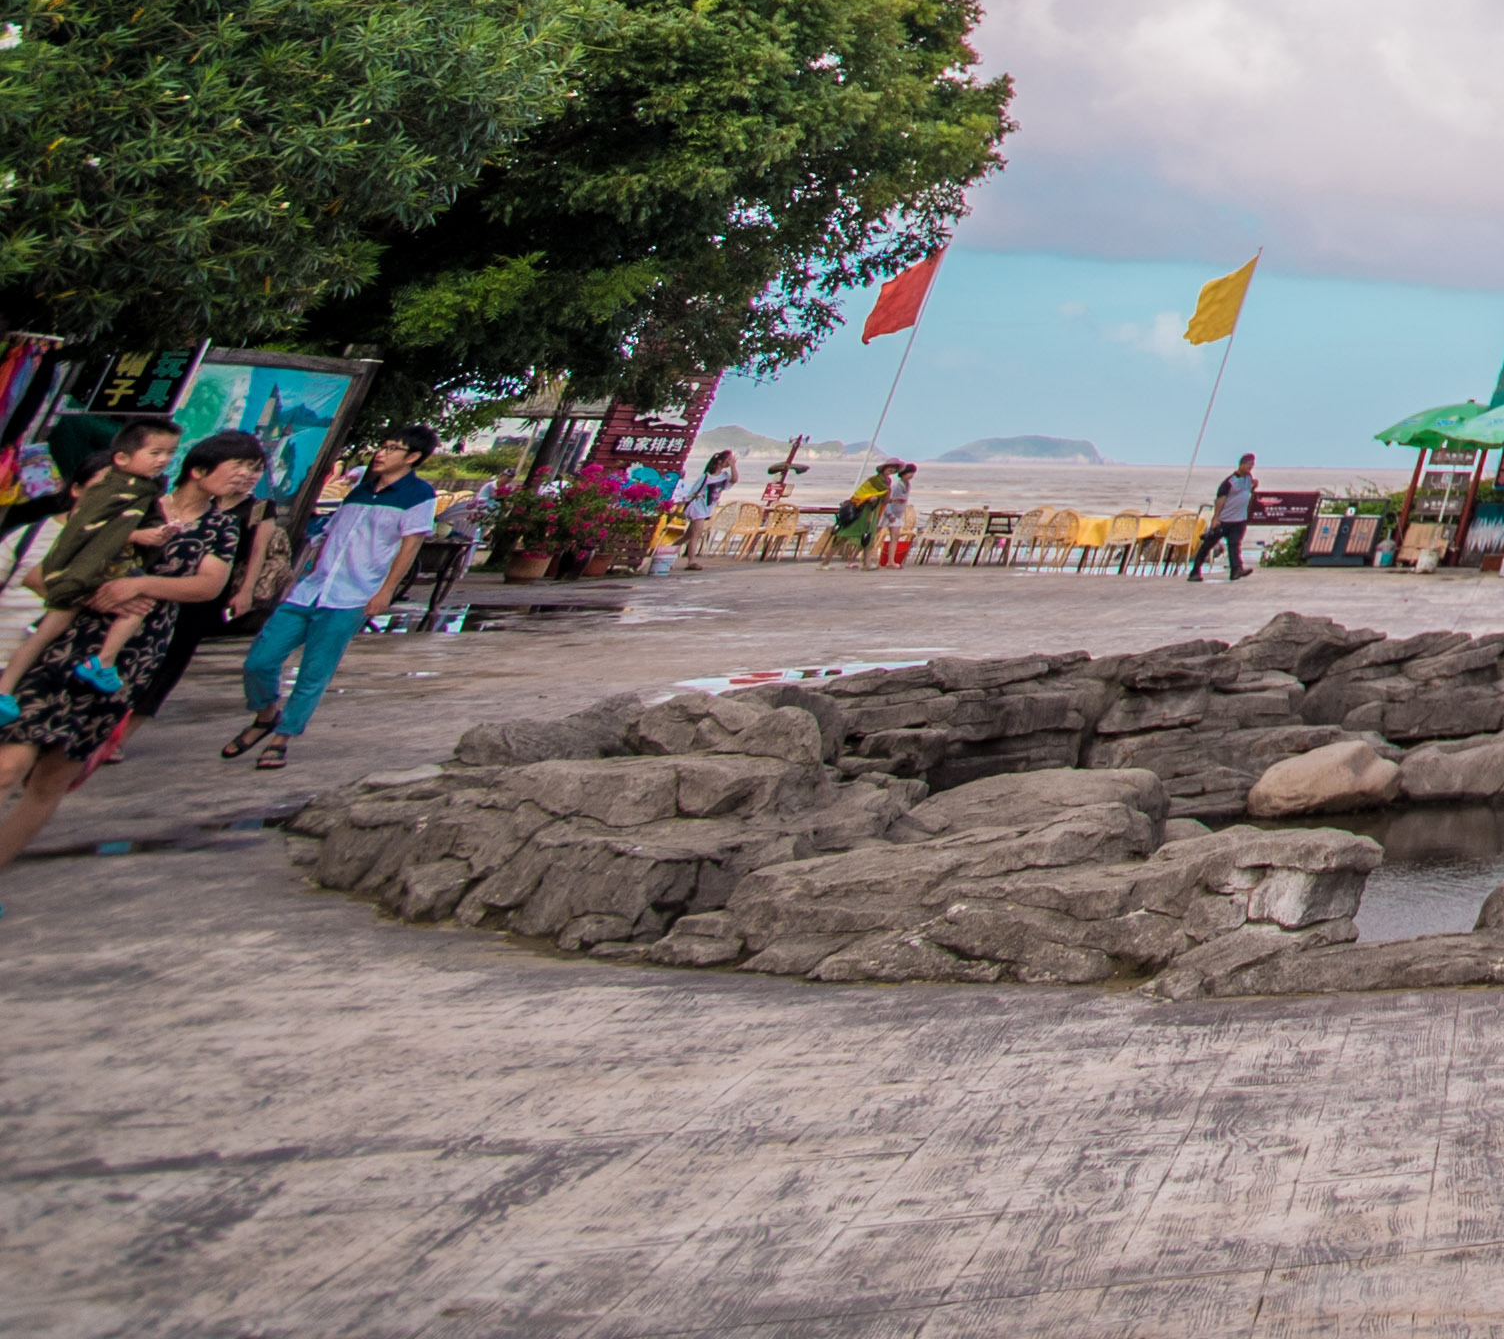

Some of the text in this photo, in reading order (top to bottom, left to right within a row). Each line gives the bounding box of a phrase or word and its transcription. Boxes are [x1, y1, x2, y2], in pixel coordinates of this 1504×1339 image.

[137, 351, 191, 407] 玩具
[615, 435, 685, 452] 渔家排档
